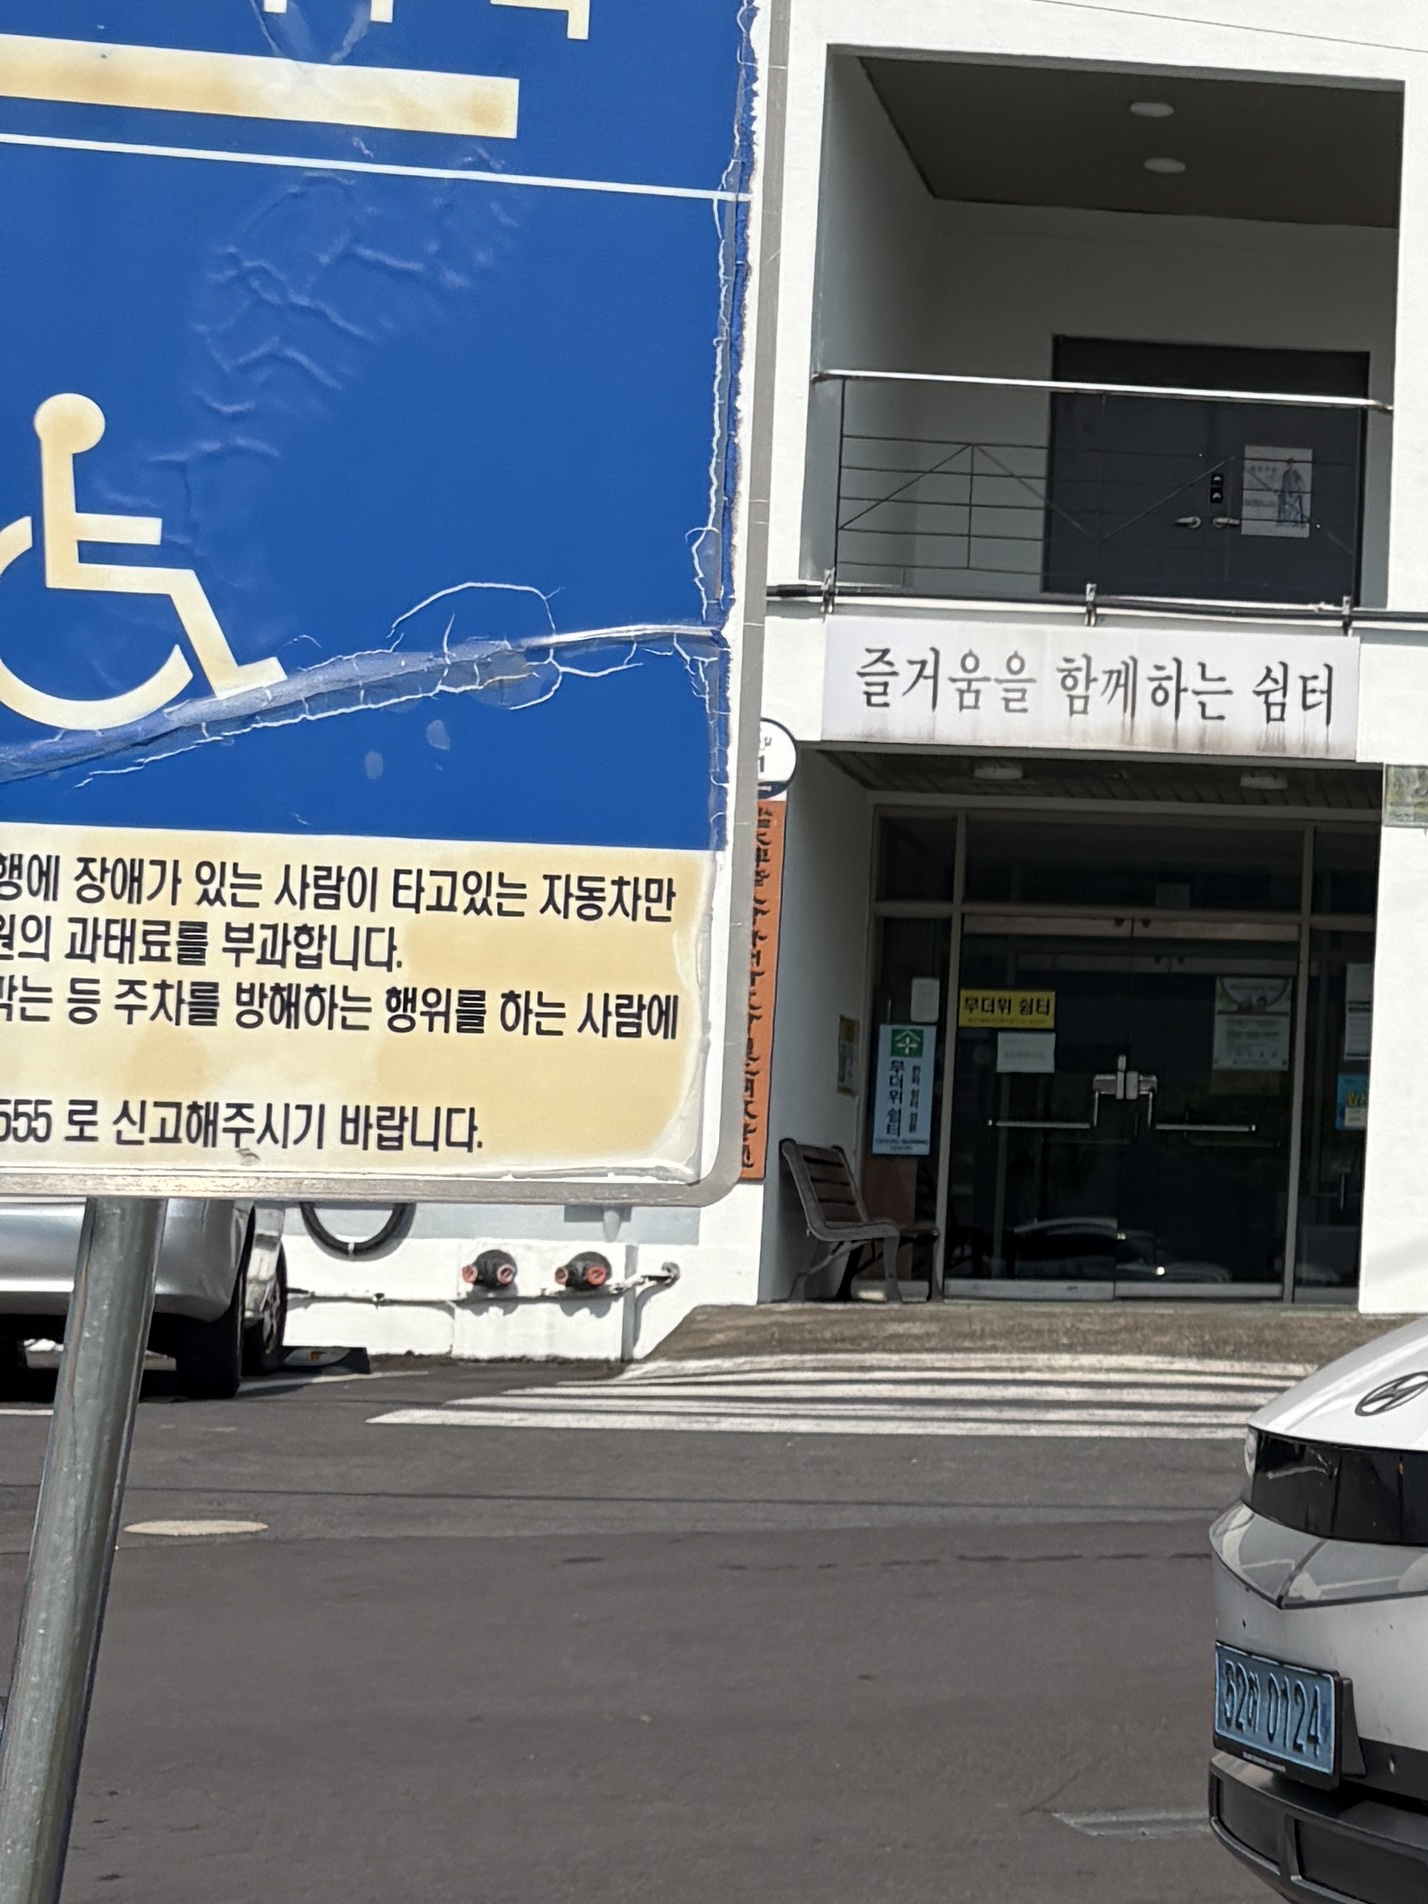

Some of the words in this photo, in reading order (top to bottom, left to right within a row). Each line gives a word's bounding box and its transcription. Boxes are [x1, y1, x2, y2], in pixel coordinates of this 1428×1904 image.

[856, 647, 1037, 713] 즐거움을
[1056, 652, 1233, 721] 함께하는
[1252, 660, 1334, 726] 쉼터
[0, 853, 60, 901] 행에
[74, 856, 182, 905] 장애가
[194, 860, 262, 908] 있는
[274, 864, 378, 912] 사람이
[392, 868, 527, 917] 타고있는
[539, 874, 676, 922] 자동차만
[64, 916, 208, 966] 과태료를
[222, 921, 402, 972] 부과합니다.
[67, 977, 101, 1025] 등
[114, 978, 220, 1026] 주차를
[235, 982, 372, 1030] 방해하는
[386, 987, 486, 1034] 행위를
[500, 990, 566, 1036] 하는
[577, 993, 679, 1040] 사람에
[64, 1100, 99, 1142] 로
[112, 1100, 326, 1149] 신고해주시기
[340, 1104, 483, 1153] 바랍니다.
